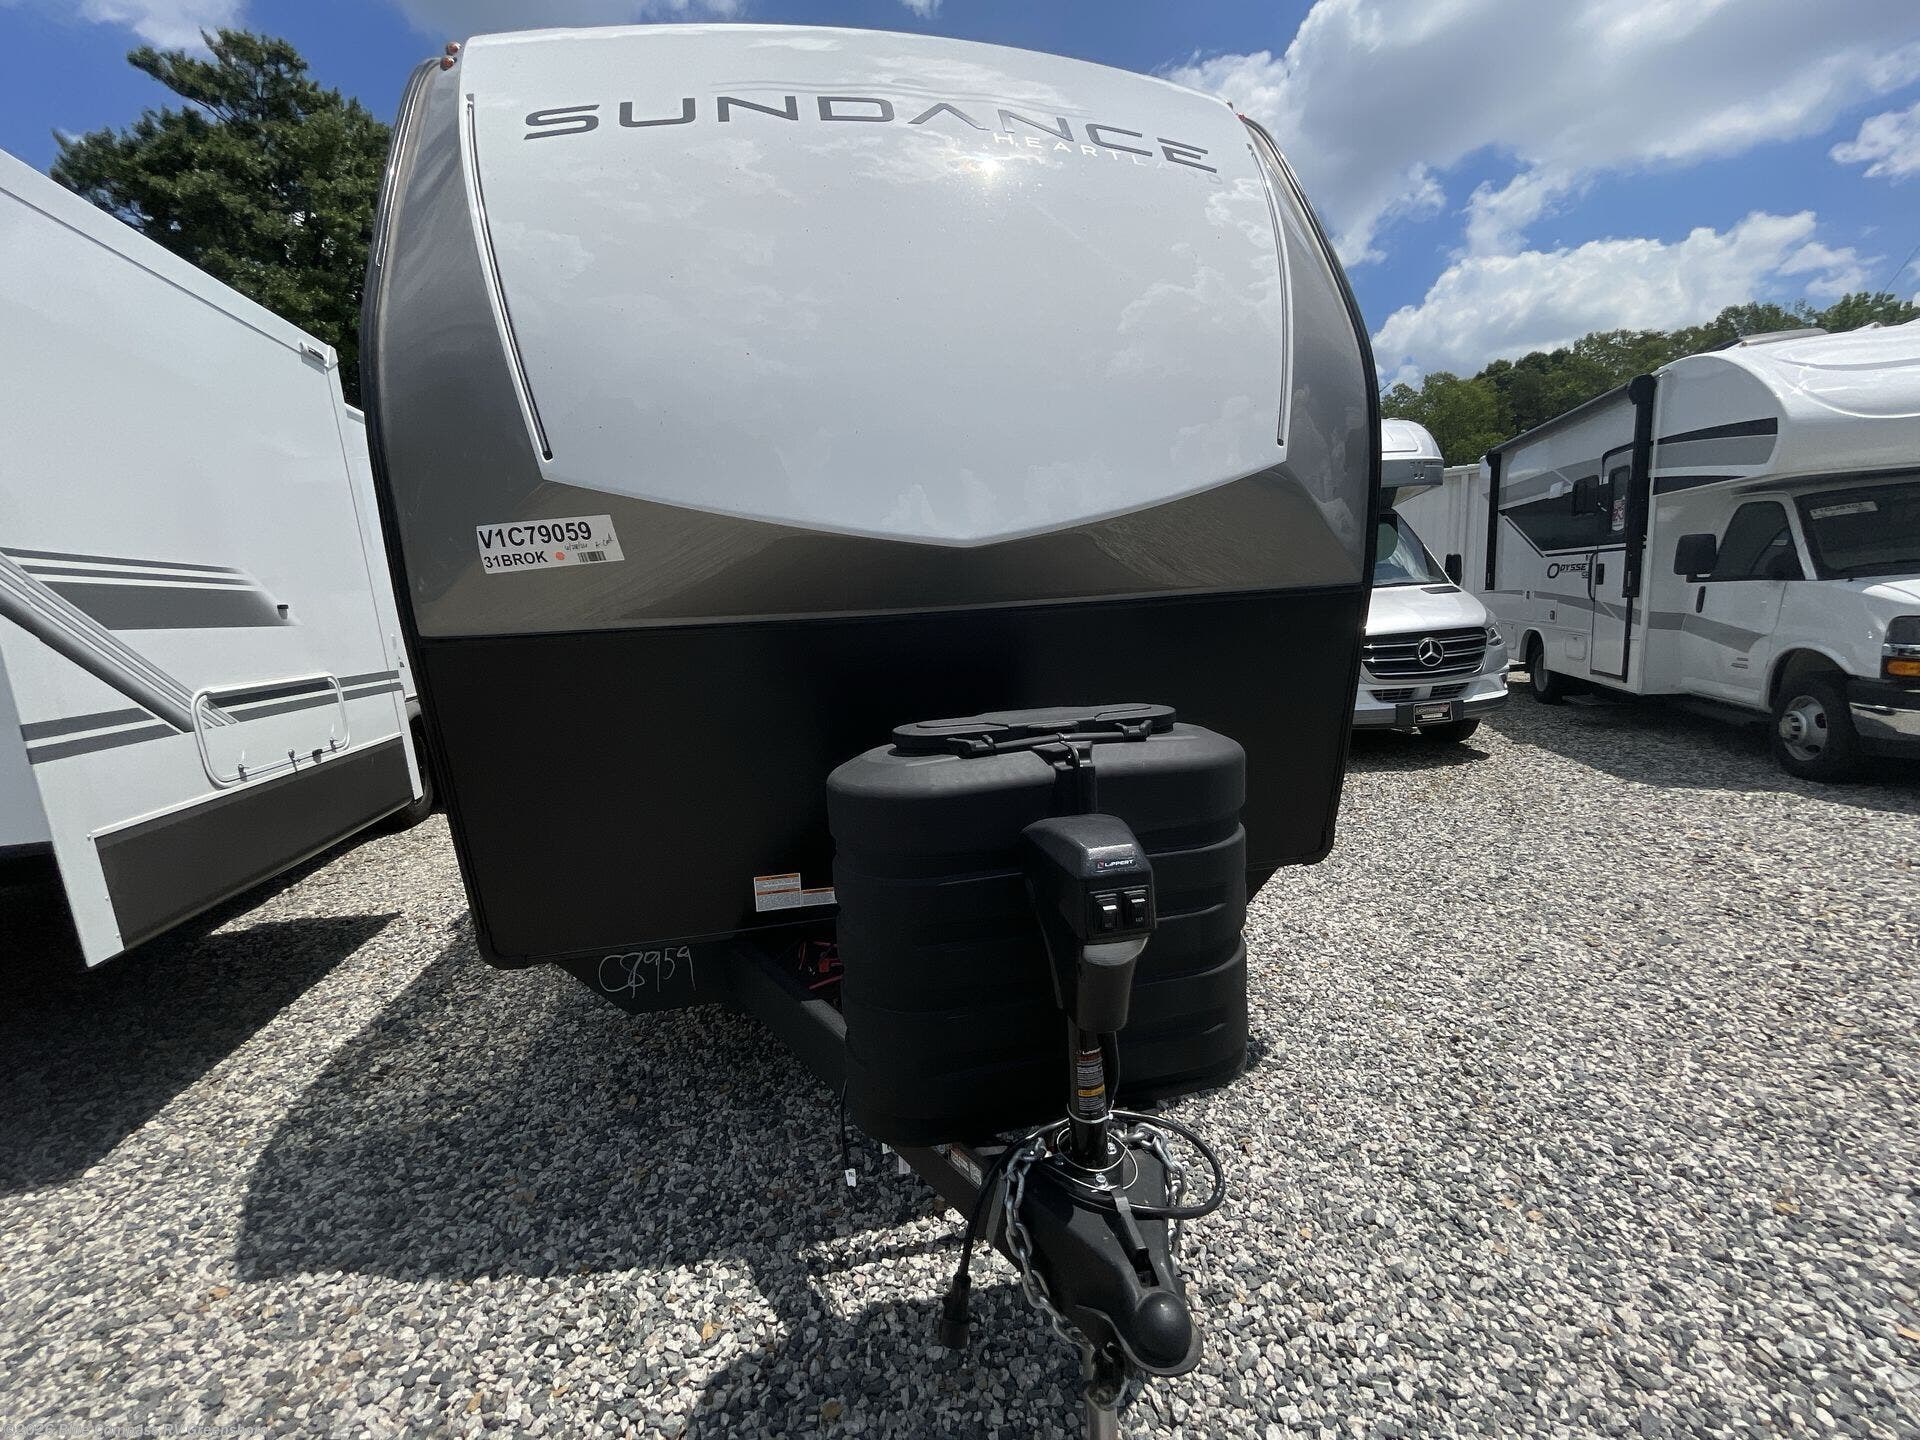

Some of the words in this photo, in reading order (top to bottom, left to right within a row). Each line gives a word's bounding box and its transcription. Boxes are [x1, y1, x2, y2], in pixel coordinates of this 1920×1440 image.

[524, 95, 1217, 175] SUNDANCE
[478, 521, 592, 549] V1C79059
[483, 551, 549, 568] 31BROK
[1547, 563, 1589, 578] ODYSSE
